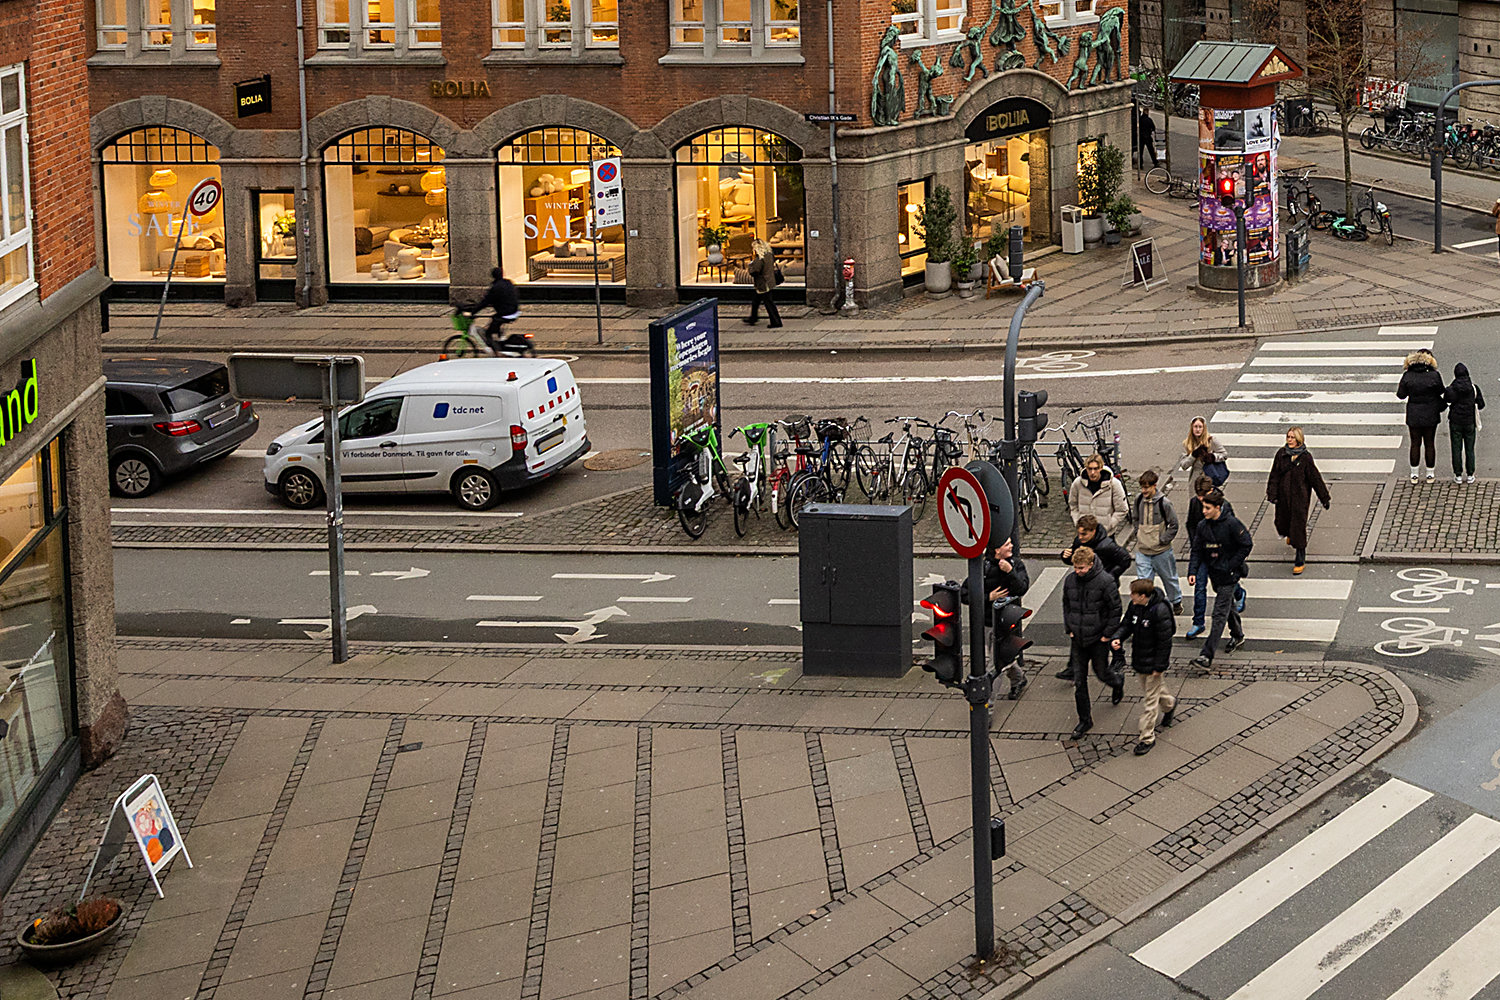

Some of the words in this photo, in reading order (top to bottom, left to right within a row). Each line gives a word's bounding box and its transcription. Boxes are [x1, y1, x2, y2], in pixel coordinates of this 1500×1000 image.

[430, 80, 492, 97] BOLIA
[240, 94, 263, 106] BOLIA
[985, 109, 1030, 132] BOLIA
[194, 189, 217, 206] 40
[544, 202, 580, 210] WINTER
[694, 331, 707, 344] your
[675, 339, 708, 361] Copenhagen
[453, 406, 468, 414] tdc
[469, 406, 484, 414] net
